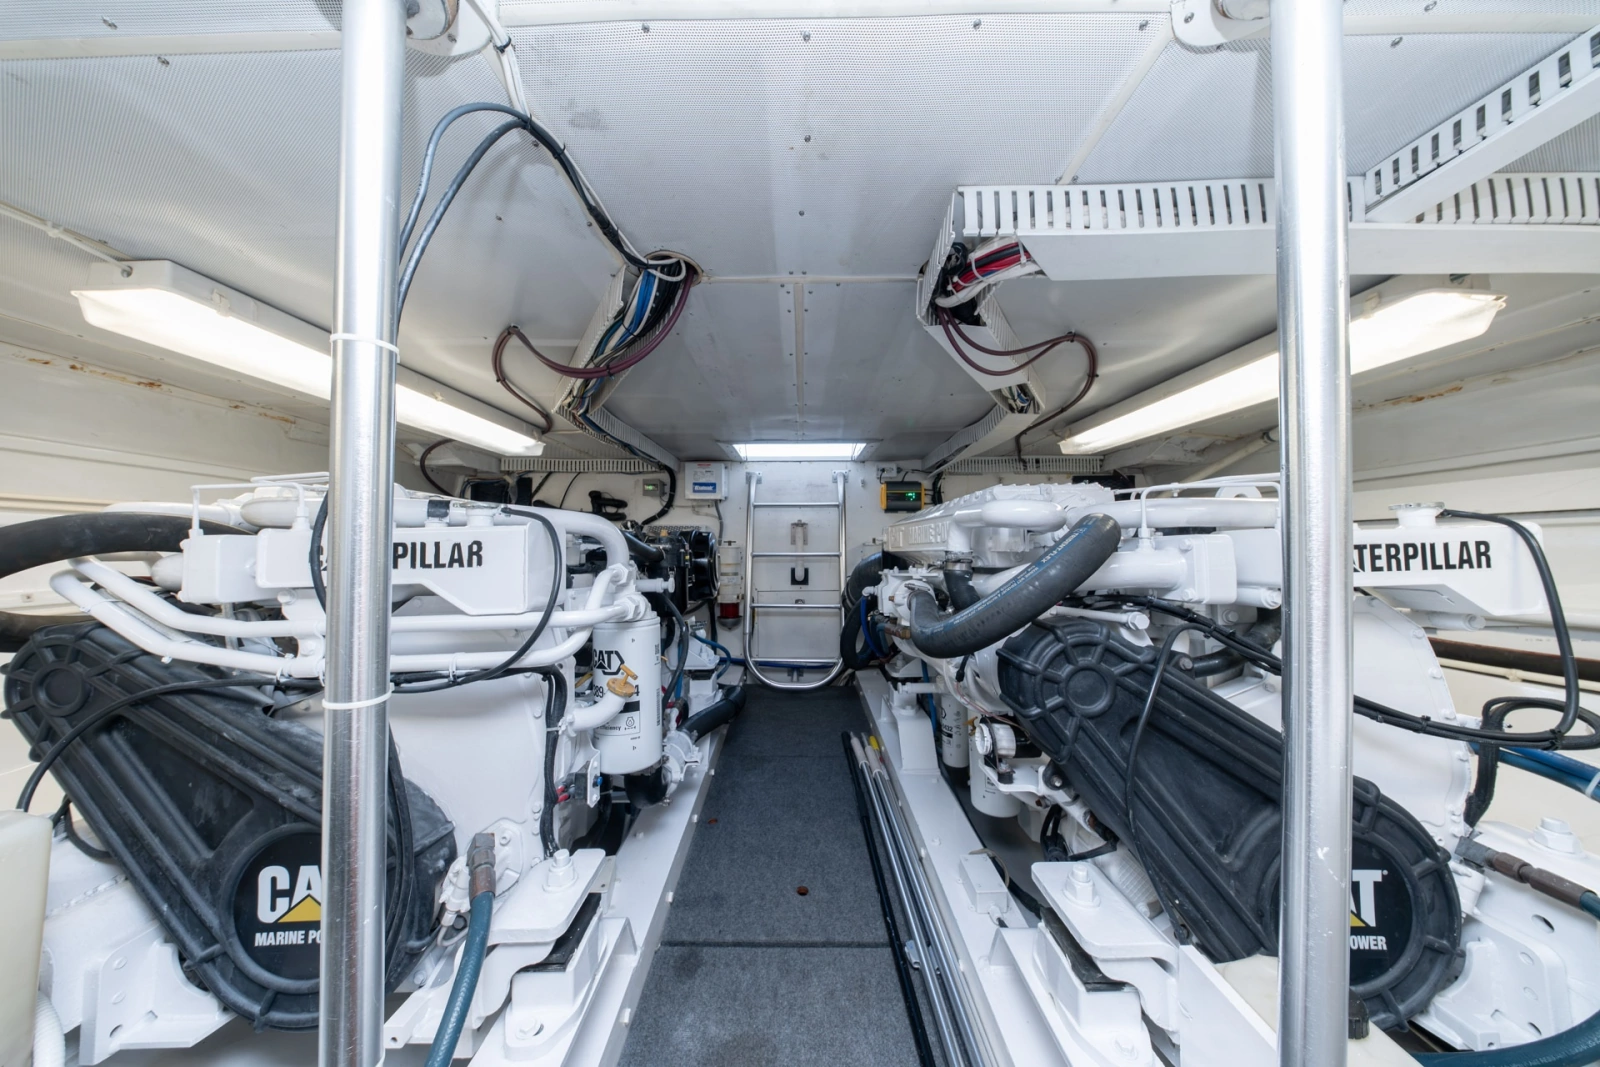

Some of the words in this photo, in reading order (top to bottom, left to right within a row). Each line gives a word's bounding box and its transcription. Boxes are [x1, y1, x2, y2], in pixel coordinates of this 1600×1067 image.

[1041, 532, 1079, 563] TRIDENT-FLEX
[1353, 540, 1492, 573] TERPILLAR
[593, 649, 613, 671] CAT
[257, 865, 322, 924] CA
[254, 930, 305, 947] MARINE
[1350, 935, 1388, 950] OWER
